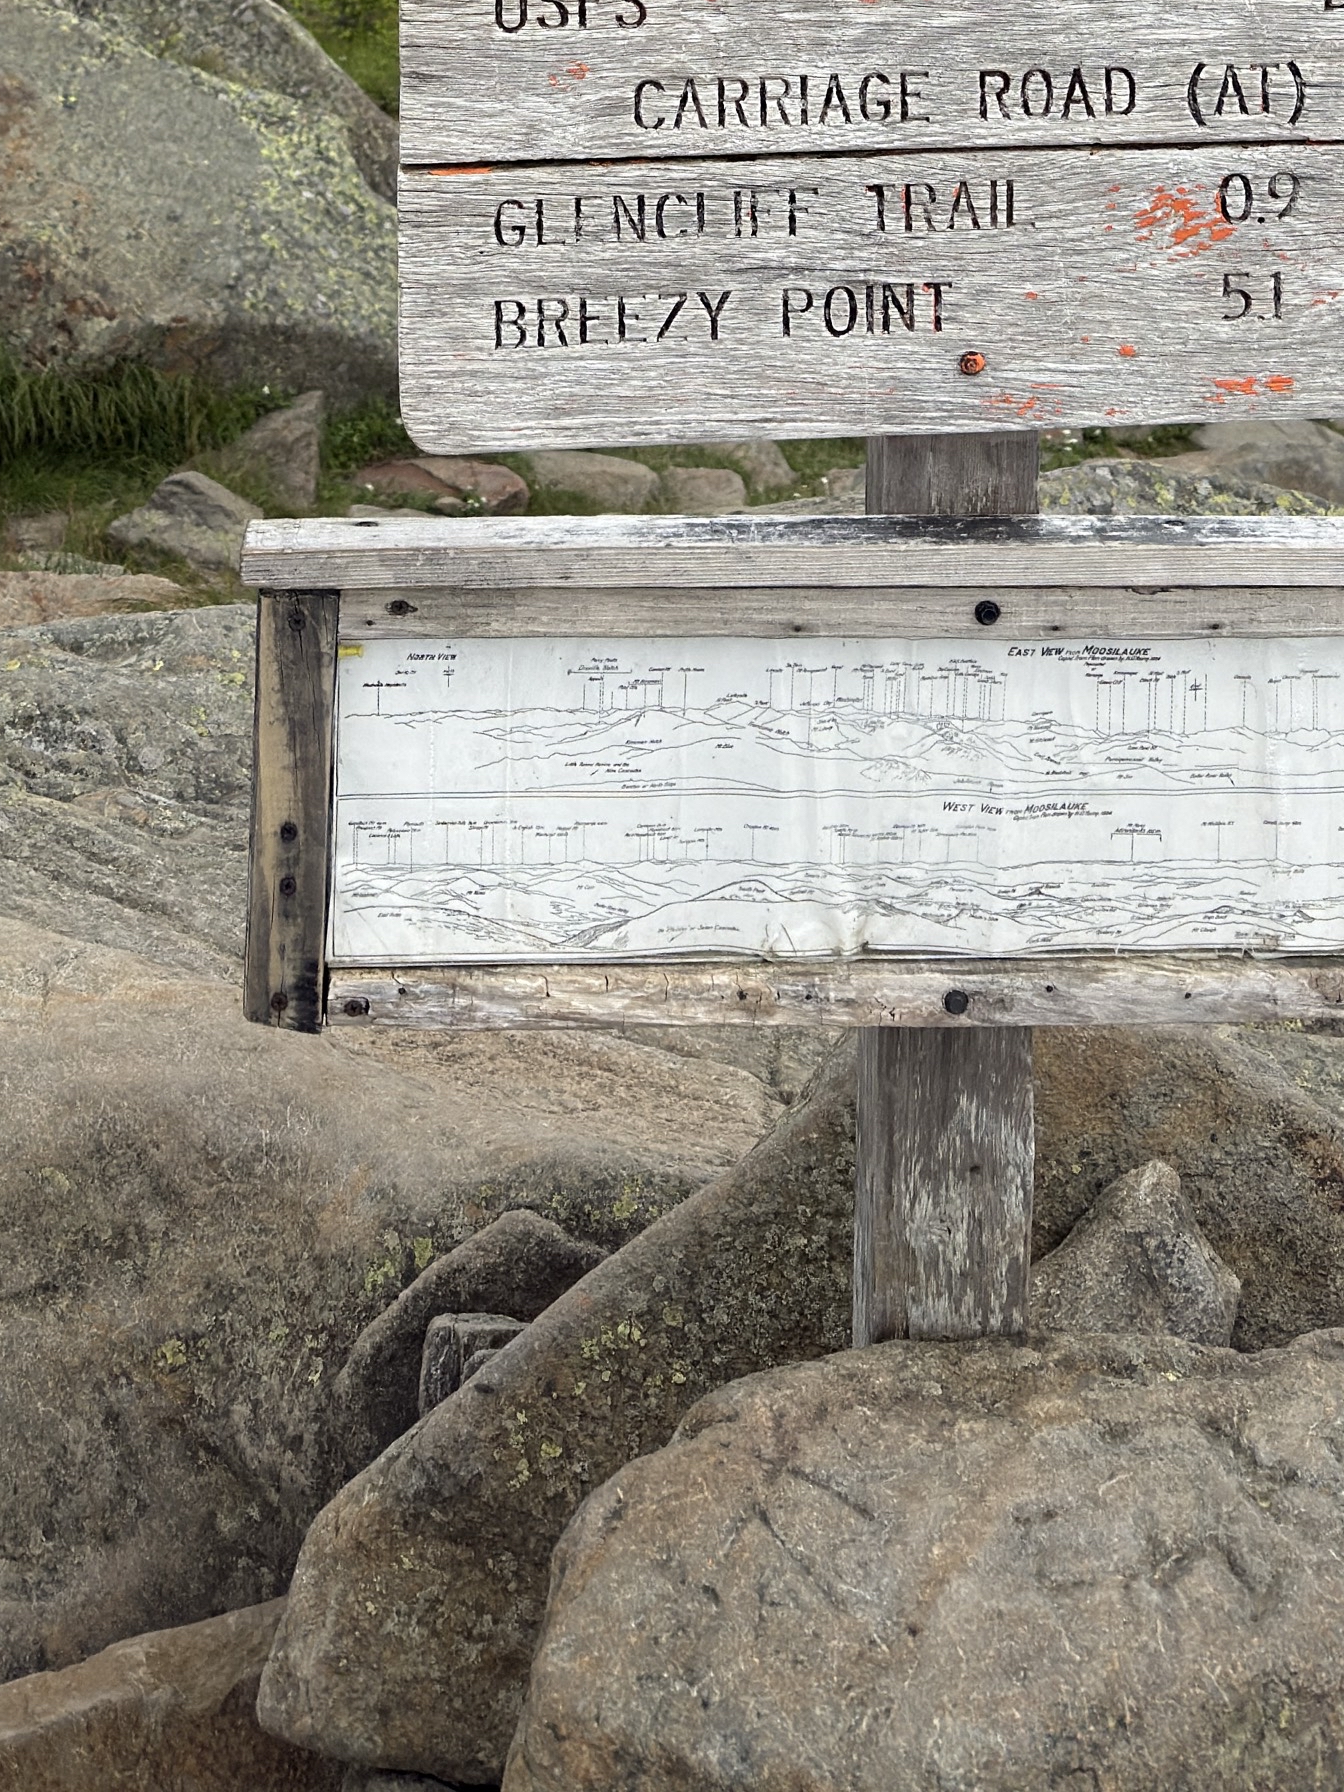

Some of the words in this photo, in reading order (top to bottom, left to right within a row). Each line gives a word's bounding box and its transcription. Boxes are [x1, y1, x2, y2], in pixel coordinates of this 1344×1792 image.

[633, 71, 931, 130] CARRIAGE
[979, 66, 1136, 121] ROAD
[1187, 60, 1306, 126] (AT)
[493, 187, 819, 247] GLENCLIFF
[865, 180, 1035, 232] TRAIL
[1219, 172, 1301, 224] 0.9
[494, 290, 732, 350] BREEZY
[781, 282, 953, 338] POINT
[1221, 271, 1283, 320] 5.1
[406, 653, 436, 661] NORTH
[437, 653, 457, 661] VIEW
[1007, 646, 1036, 657] EAST
[1041, 646, 1065, 656] VIEW
[1081, 645, 1152, 656] MOOSILAUKE
[942, 801, 976, 812] WEST
[980, 803, 1004, 815] VIEW
[1023, 802, 1089, 815] MOOSILAUKE
